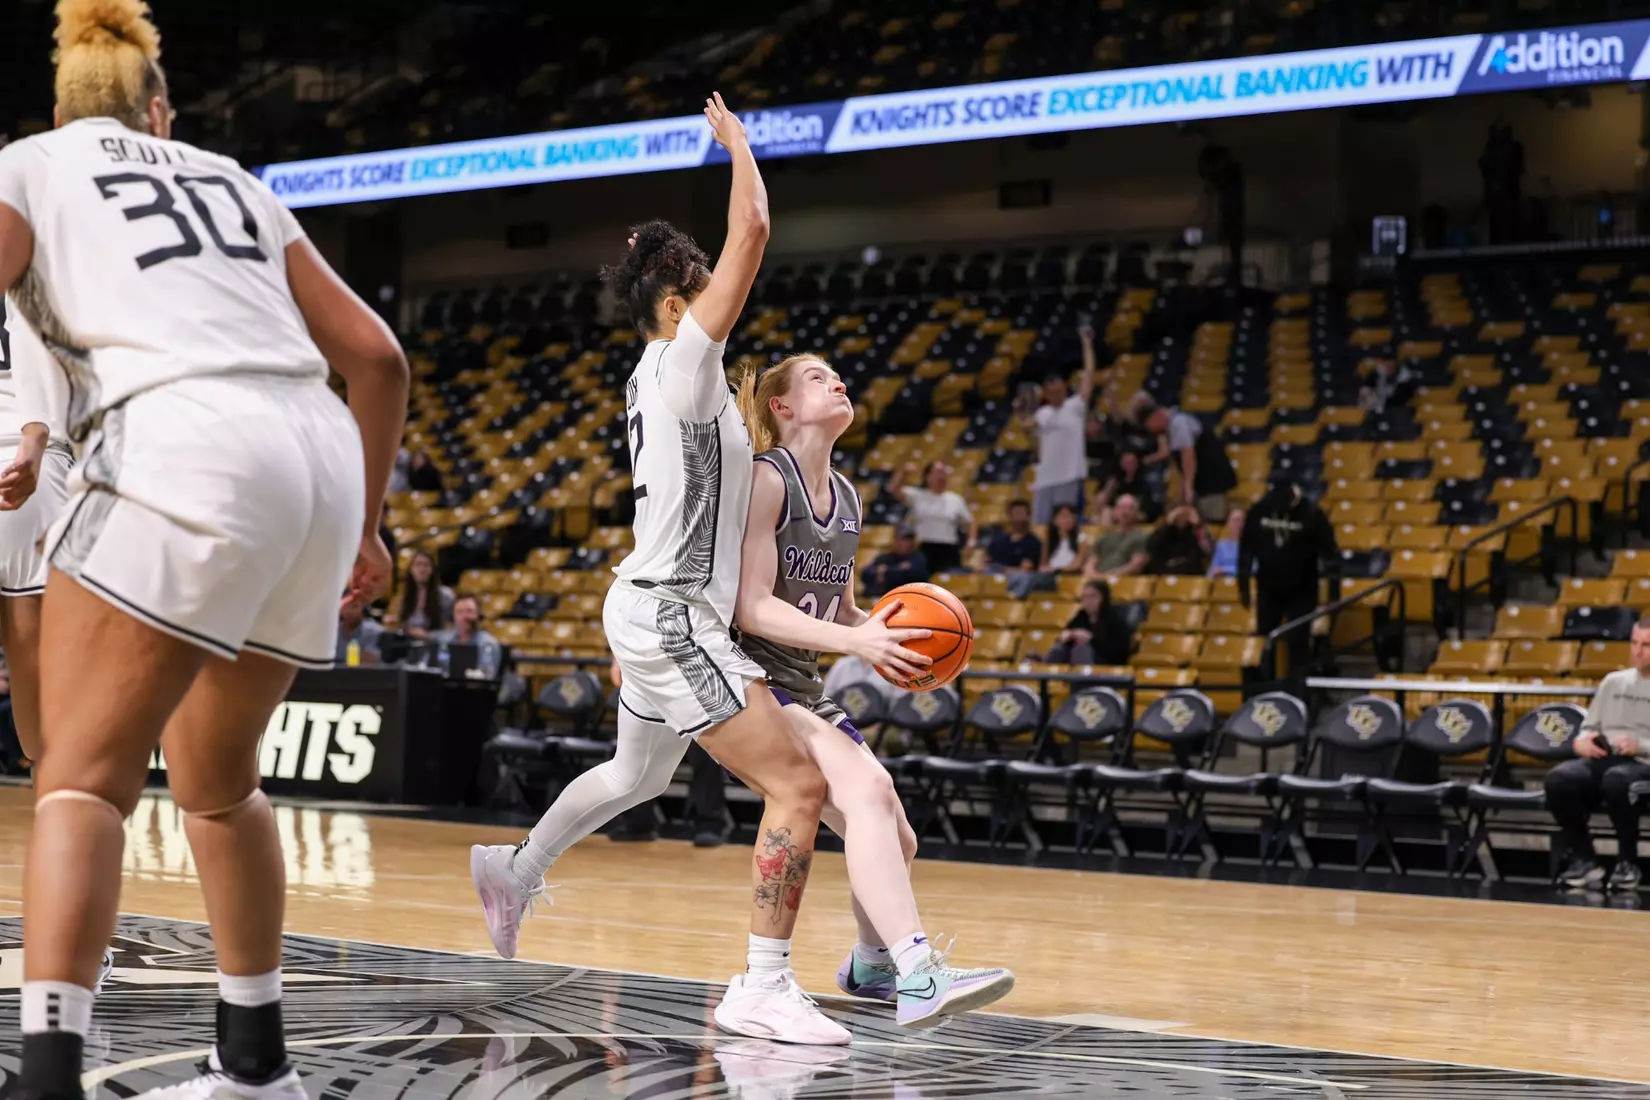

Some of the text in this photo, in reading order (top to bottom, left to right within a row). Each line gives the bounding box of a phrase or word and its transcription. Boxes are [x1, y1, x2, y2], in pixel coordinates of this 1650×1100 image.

[850, 31, 1625, 137] KNIGHTS SCORE EXCEPTIONAL BANKING WITH Addition
[270, 166, 343, 195] KNIGHTS
[349, 161, 406, 186] SCORE
[409, 146, 536, 182] EXCEPTIONAL
[543, 132, 640, 167] BANKING
[643, 128, 702, 156] WITH
[92, 172, 268, 271] 30
